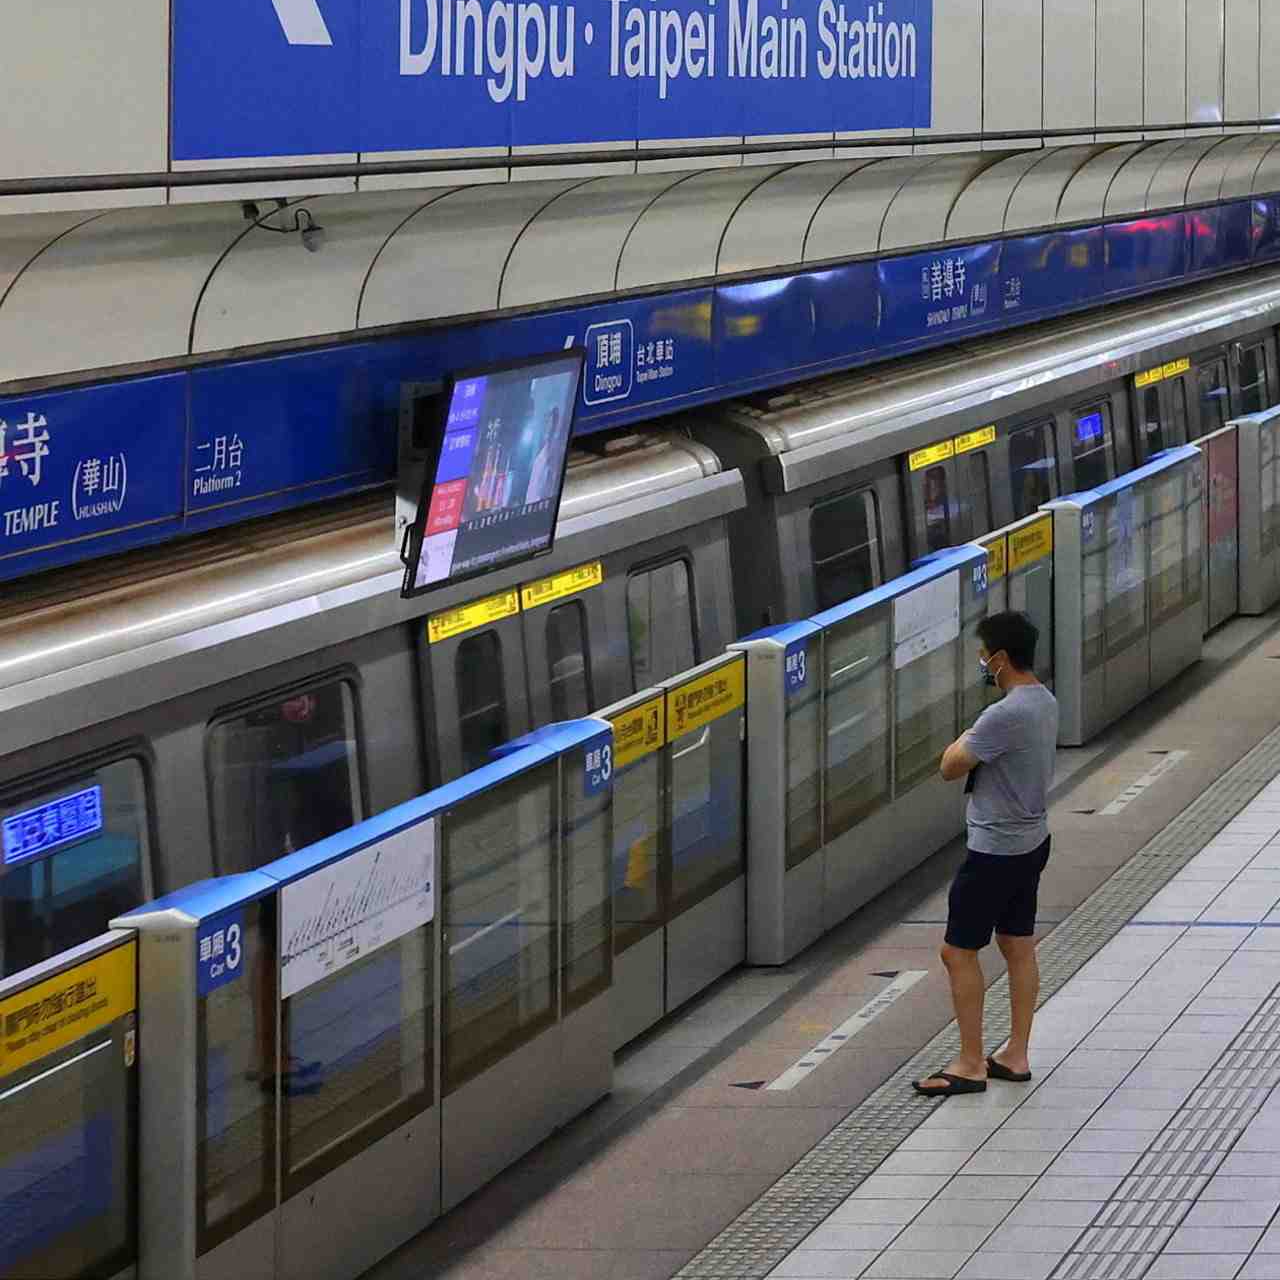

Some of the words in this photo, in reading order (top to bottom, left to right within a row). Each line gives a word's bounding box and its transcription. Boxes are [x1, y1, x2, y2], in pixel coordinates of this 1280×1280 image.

[0, 412, 50, 487] 寺
[195, 433, 244, 472] 二月台
[193, 475, 234, 497] Platform
[235, 471, 241, 487] 2
[4, 501, 60, 537] TEMPLE
[798, 650, 806, 681] 3
[602, 744, 611, 781] 3
[227, 923, 240, 969] 3
